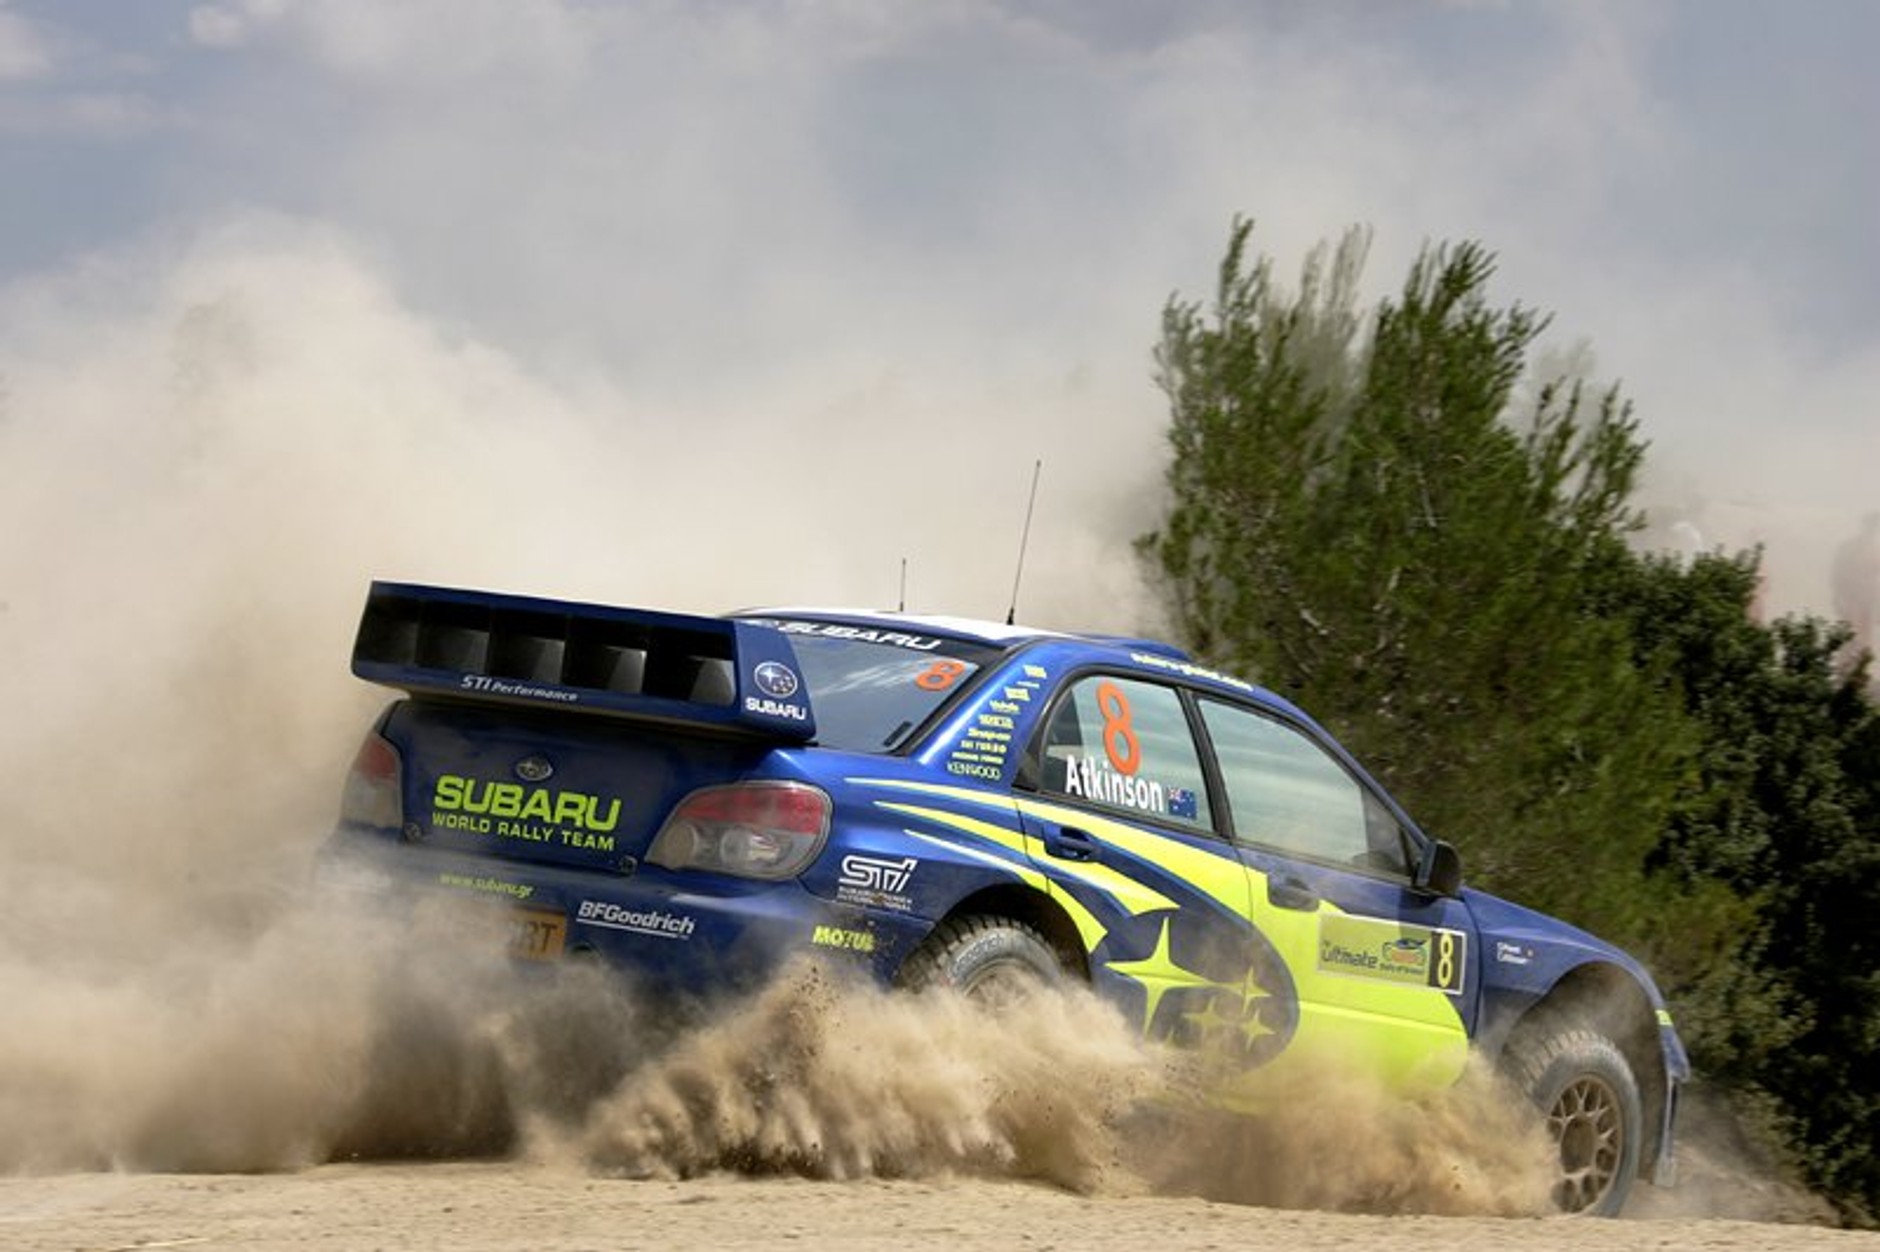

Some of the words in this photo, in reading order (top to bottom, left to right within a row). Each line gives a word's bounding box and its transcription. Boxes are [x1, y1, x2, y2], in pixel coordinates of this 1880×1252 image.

[777, 620, 941, 651] SUBARU
[491, 681, 579, 702] Performance
[914, 660, 966, 692] 8
[745, 696, 807, 721] SUBARU
[1095, 679, 1142, 777] 8
[1065, 754, 1165, 813] Atkinson
[434, 774, 622, 832] SUBARU
[432, 812, 492, 834] WORLD
[497, 821, 553, 843] RALLY
[561, 829, 615, 851] TEAM
[577, 899, 696, 936] BFGoodrich
[1436, 933, 1453, 988] 8
